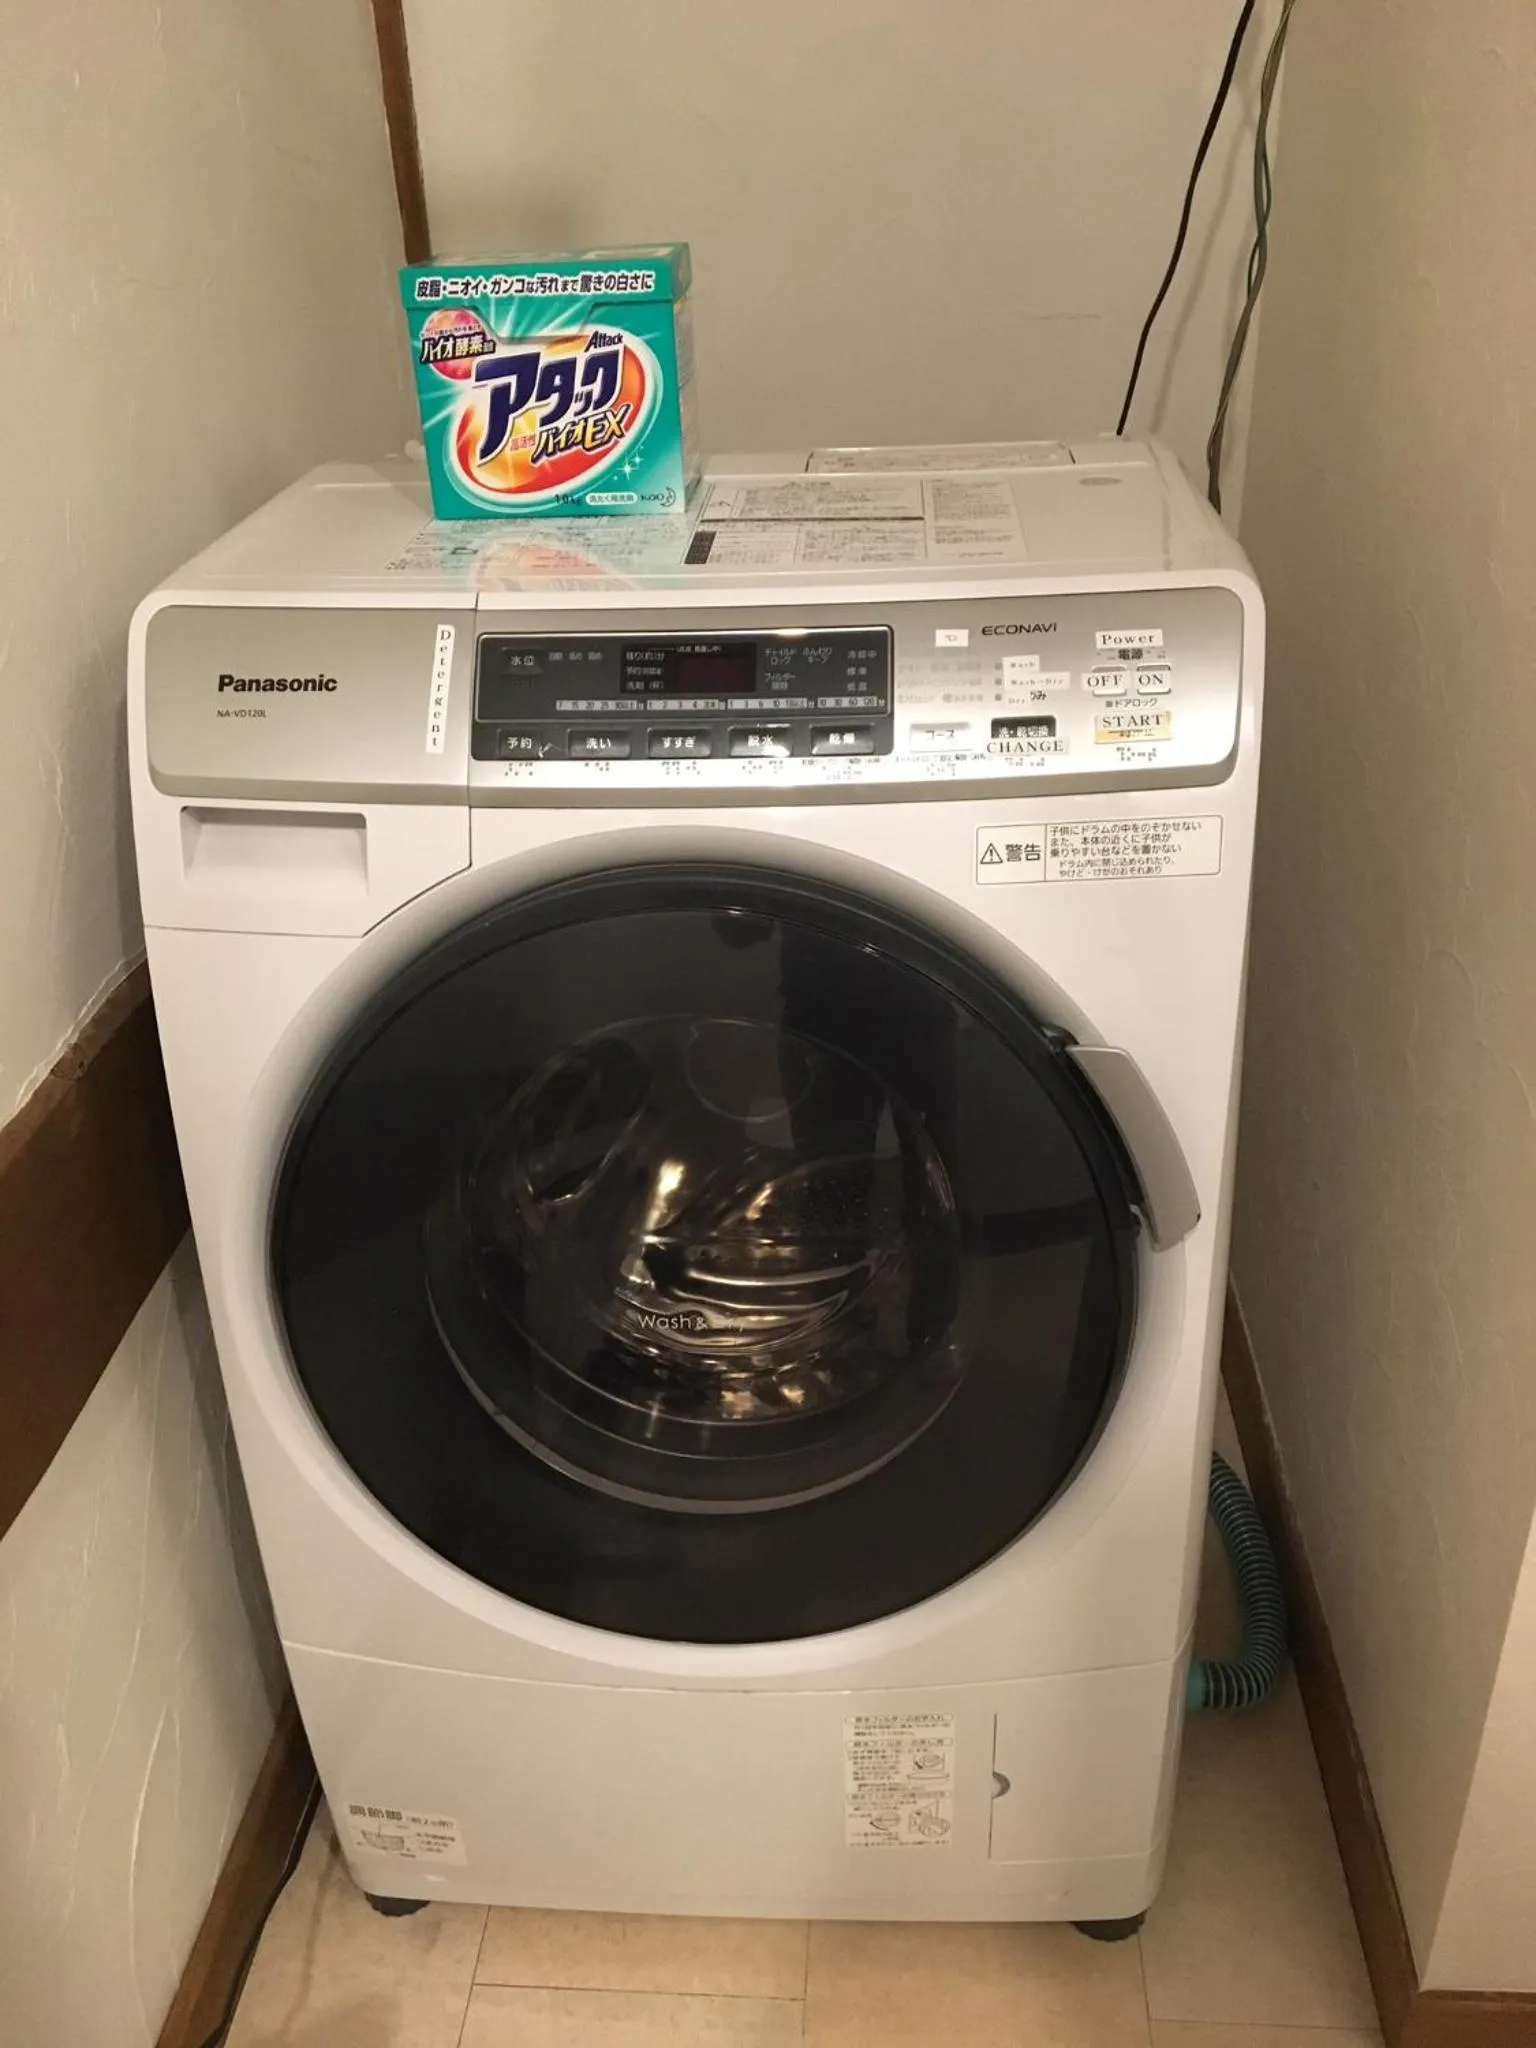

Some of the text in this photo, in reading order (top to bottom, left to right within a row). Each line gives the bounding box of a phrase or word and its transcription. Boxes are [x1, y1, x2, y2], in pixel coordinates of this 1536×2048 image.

[586, 330, 623, 351] Attack
[474, 348, 619, 461] アタック
[981, 623, 1057, 636] ECONAVI
[1101, 634, 1155, 646] Power
[218, 674, 338, 692] Panasonic
[1087, 674, 1123, 688] OFF
[1138, 673, 1164, 686] ON
[431, 629, 451, 747] Detergent
[1102, 713, 1164, 728] START
[507, 737, 532, 749] 予約
[585, 737, 612, 749] 洗い
[661, 736, 697, 749] すすぎ
[747, 735, 774, 747] 脱水
[986, 740, 1065, 754] CHANGE
[1005, 844, 1041, 862] 警告
[638, 1315, 692, 1329] Wash
[694, 1316, 707, 1331] &
